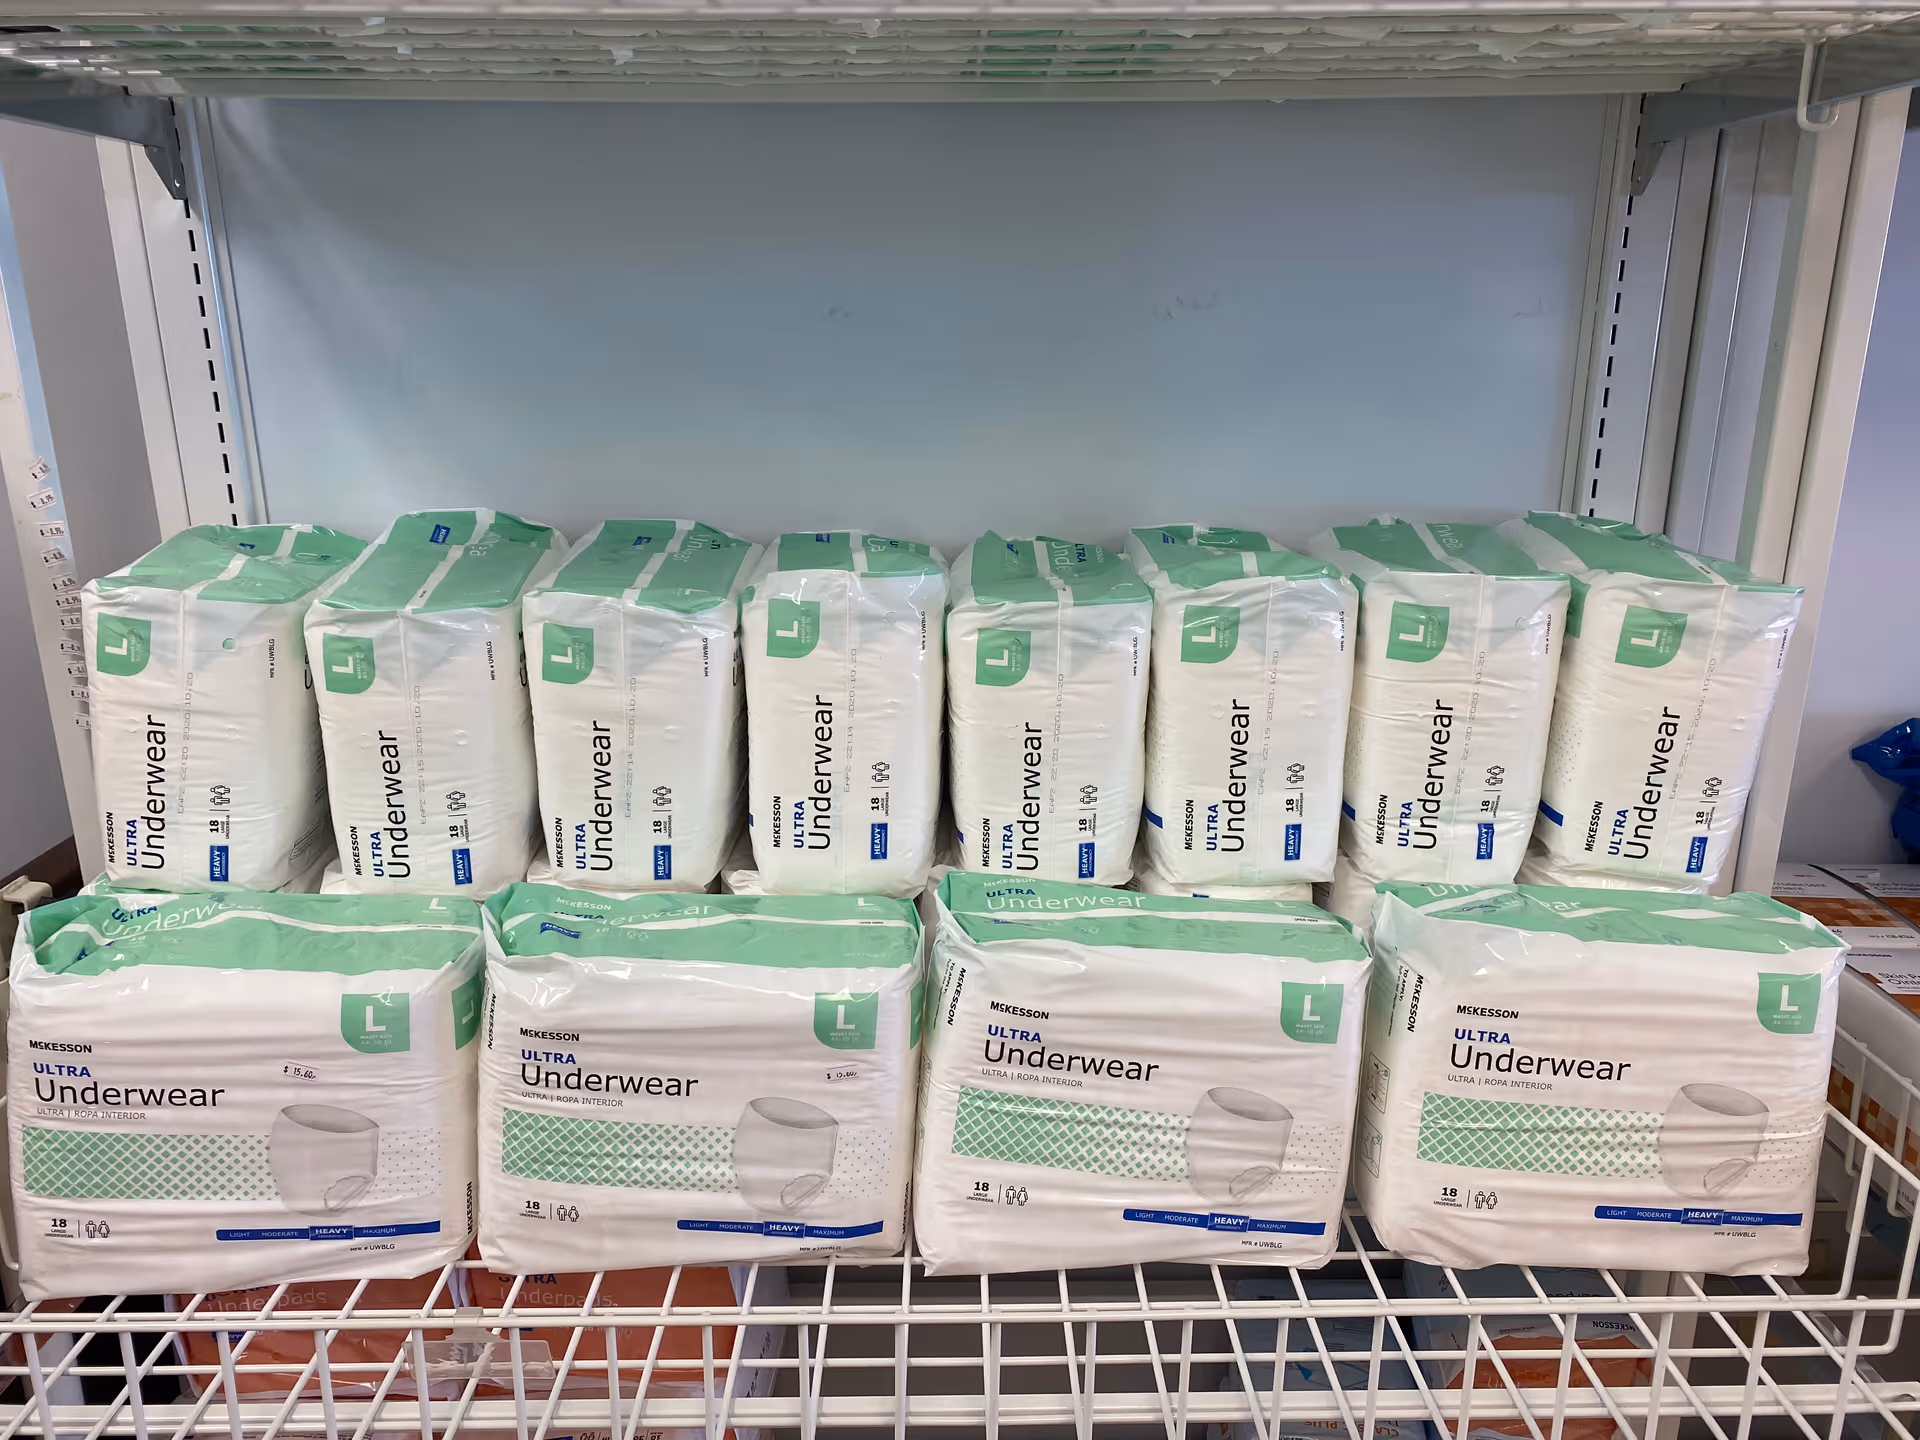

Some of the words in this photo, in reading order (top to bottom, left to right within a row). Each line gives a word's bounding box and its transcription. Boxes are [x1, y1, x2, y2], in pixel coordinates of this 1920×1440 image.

[776, 621, 798, 637] L
[1192, 626, 1216, 642] L
[1399, 625, 1424, 642] L
[1631, 630, 1659, 647] L
[105, 638, 127, 655] L
[551, 646, 572, 663] L
[332, 657, 353, 673] L
[986, 650, 1008, 666] L
[808, 695, 832, 849] Underwear
[1221, 699, 1250, 851] Underwear
[1413, 699, 1454, 849] Underwear
[141, 715, 166, 869] Underwear
[1624, 707, 1680, 859] Underwear
[378, 730, 410, 878] Underwear
[589, 720, 612, 871] Underwear
[871, 798, 879, 810] 18
[1017, 722, 1042, 870] Underwear
[1286, 799, 1294, 811] 18
[1481, 800, 1490, 812] 18
[210, 820, 218, 833] 18
[653, 821, 661, 833] 18
[794, 801, 804, 848] ULTRA
[1079, 819, 1087, 832] 18
[1185, 800, 1194, 850] McKESSON
[1207, 804, 1218, 850] ULTRA
[1376, 794, 1388, 844] McKESSON
[1398, 801, 1413, 847] ULTRA
[1585, 801, 1603, 852] McKESSON
[1696, 812, 1705, 824] 18
[106, 812, 115, 863] McKESSON
[449, 825, 458, 838] 18
[1480, 828, 1488, 854] HEAVY
[1608, 809, 1629, 855] ULTRA
[126, 819, 137, 866] ULTRA
[350, 826, 362, 875] McKESSON
[555, 818, 563, 868] McKESSON
[575, 824, 586, 869] ULTRA
[982, 818, 990, 867] McKESSON
[1003, 824, 1013, 869] ULTRA
[370, 832, 384, 877] ULTRA
[1690, 841, 1701, 868] HEAVY
[987, 888, 1035, 897] ULTRA
[430, 898, 447, 909] L
[987, 895, 1146, 910] Underwear
[1303, 995, 1320, 1020] L
[1780, 985, 1798, 1011] L
[366, 1006, 386, 1031] L
[837, 1005, 855, 1029] L
[990, 1001, 1049, 1019] McKESSON
[1457, 1005, 1519, 1019] McKESSON
[520, 1027, 579, 1041] McKESSON
[988, 1024, 1042, 1042] ULTRA
[1454, 1028, 1510, 1044] ULTRA
[29, 1040, 92, 1053] McKESSON
[521, 1049, 576, 1064] ULTRA
[984, 1040, 1159, 1082] Underwear
[1451, 1044, 1631, 1081] Underwear
[33, 1062, 91, 1077] ULTRA
[982, 1068, 1008, 1078] ULTRA
[1017, 1072, 1039, 1082] ROPA
[1042, 1076, 1083, 1088] INTERIOR
[521, 1063, 698, 1096] Underwear
[1448, 1074, 1475, 1084] ULTRA
[1510, 1081, 1553, 1090] INTERIOR
[35, 1078, 225, 1106] Underwear
[522, 1091, 547, 1100] ULTRA
[556, 1096, 579, 1104] ROPA
[582, 1098, 623, 1107] INTERIOR
[37, 1108, 64, 1116] ULTRA
[102, 1111, 146, 1119] INTERIOR
[974, 1182, 989, 1191] 18
[1442, 1187, 1457, 1197] 18
[525, 1200, 540, 1210] 18
[51, 1219, 67, 1227] 18
[1164, 1215, 1198, 1223] MODERATE
[1214, 1217, 1244, 1226] HEAVY
[208, 1288, 328, 1311] Undepads
